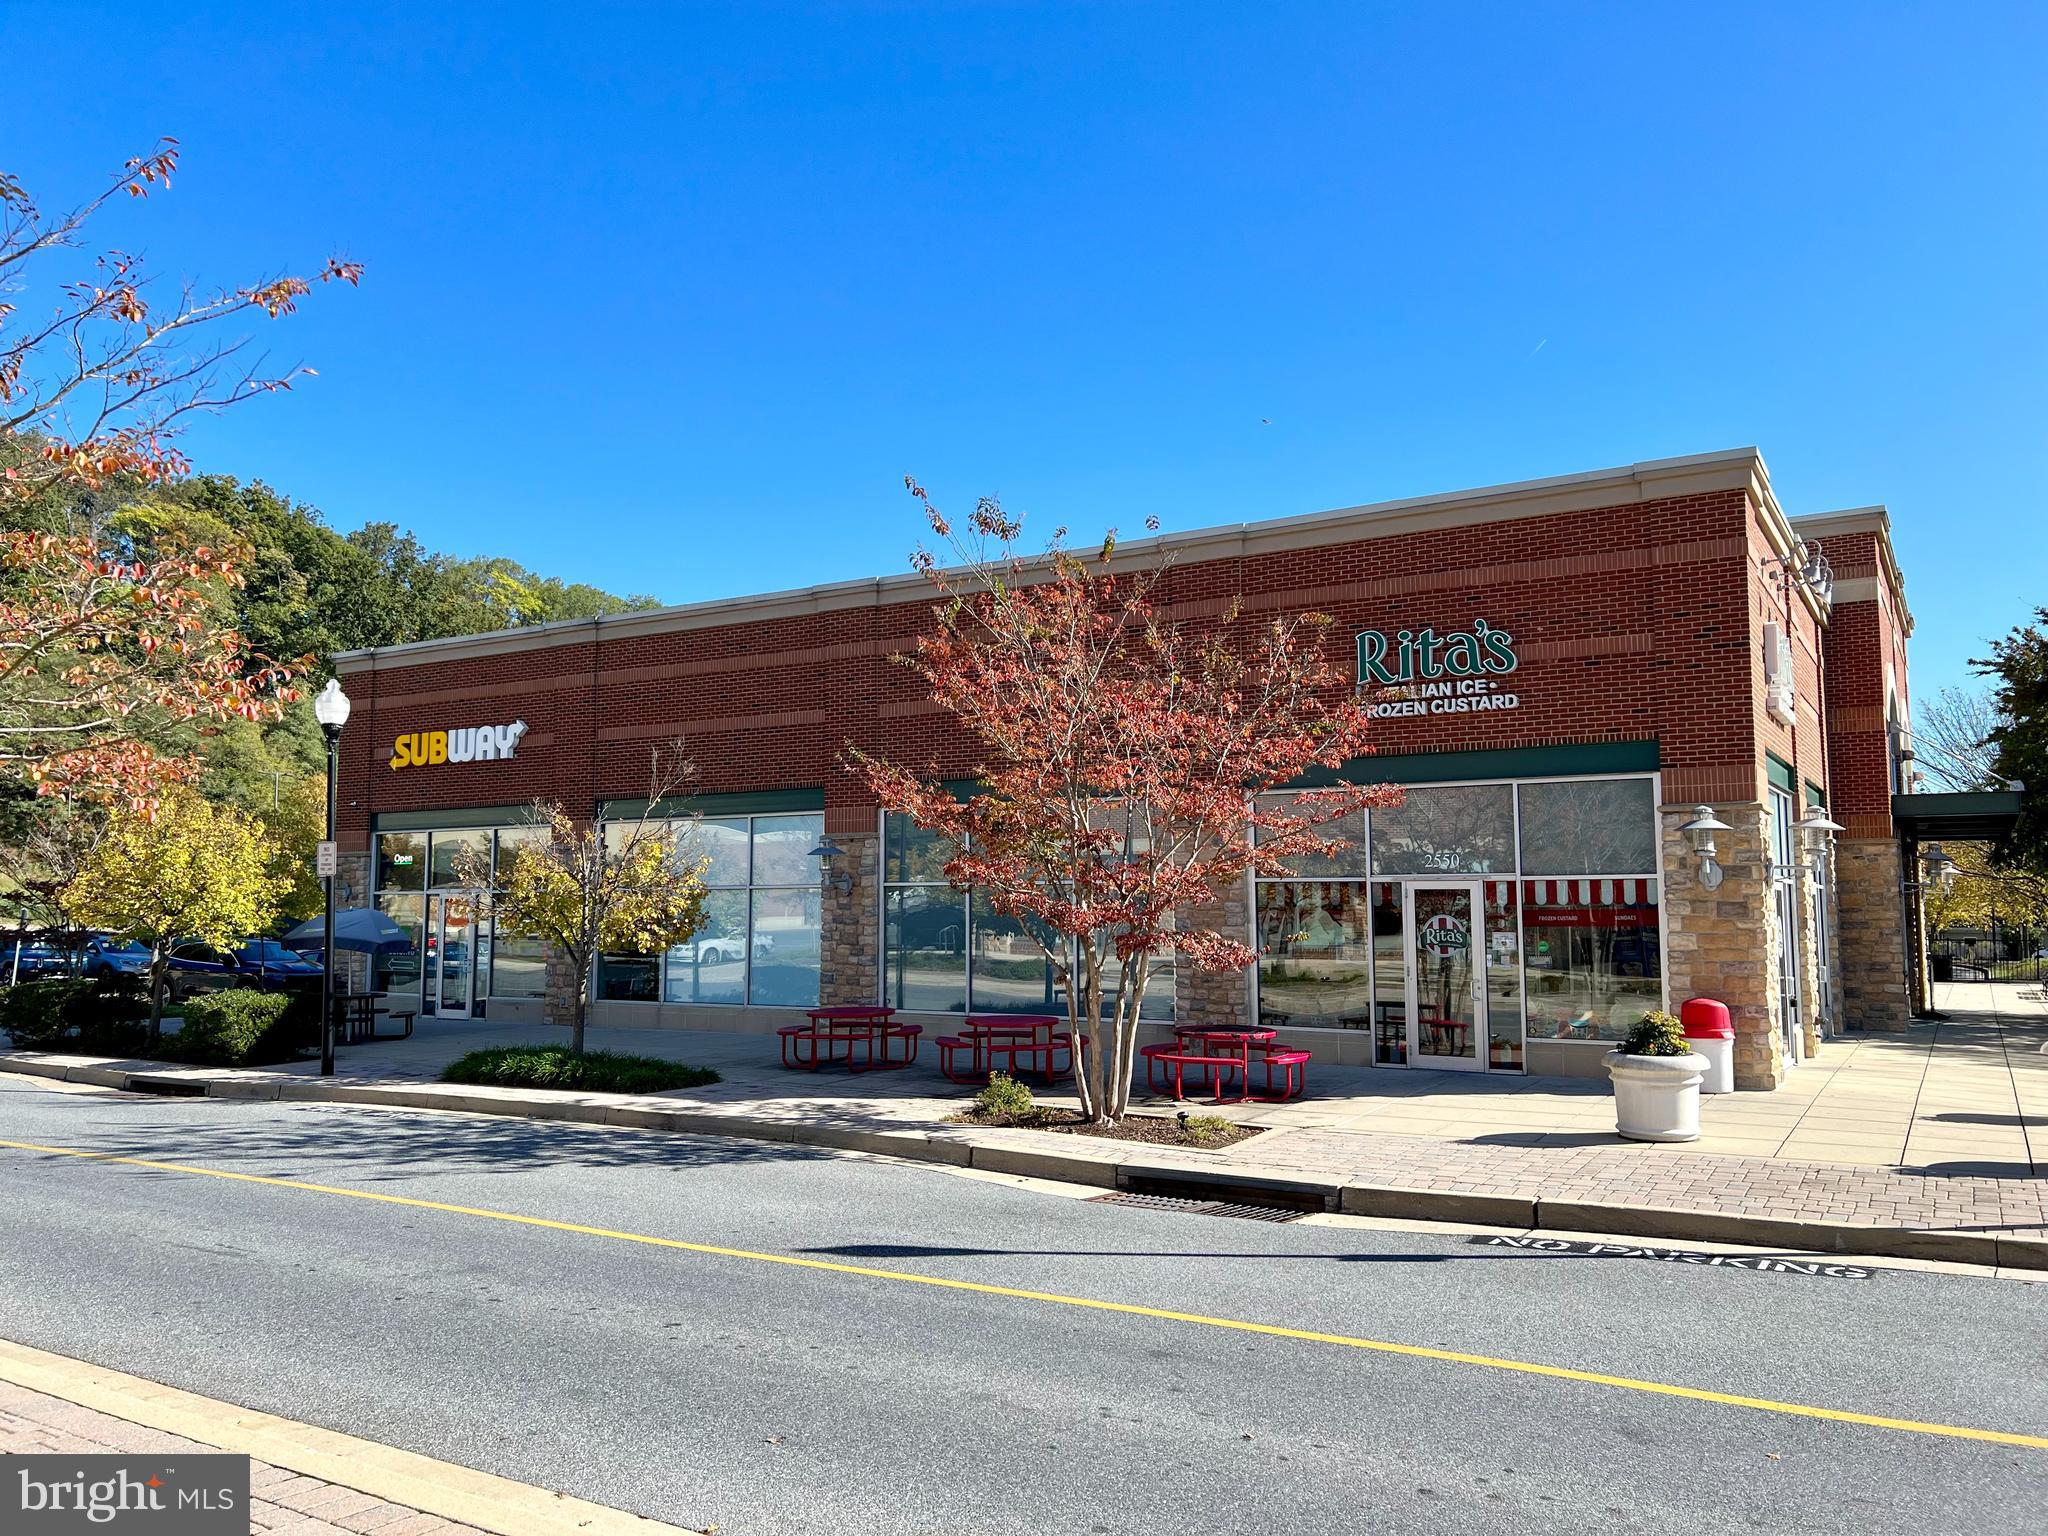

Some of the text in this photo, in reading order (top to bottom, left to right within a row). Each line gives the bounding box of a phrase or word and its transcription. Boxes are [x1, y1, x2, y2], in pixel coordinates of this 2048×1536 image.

[1355, 618, 1519, 684] Rita's
[1383, 679, 1488, 700] LIAN ICE
[1431, 694, 1520, 713] CUSTARD
[389, 719, 529, 770] SUBWAY
[394, 854, 413, 863] Open
[1424, 854, 1460, 868] 2550
[1426, 928, 1463, 944] Rita's
[1489, 1236, 1868, 1279] NO PARKING
